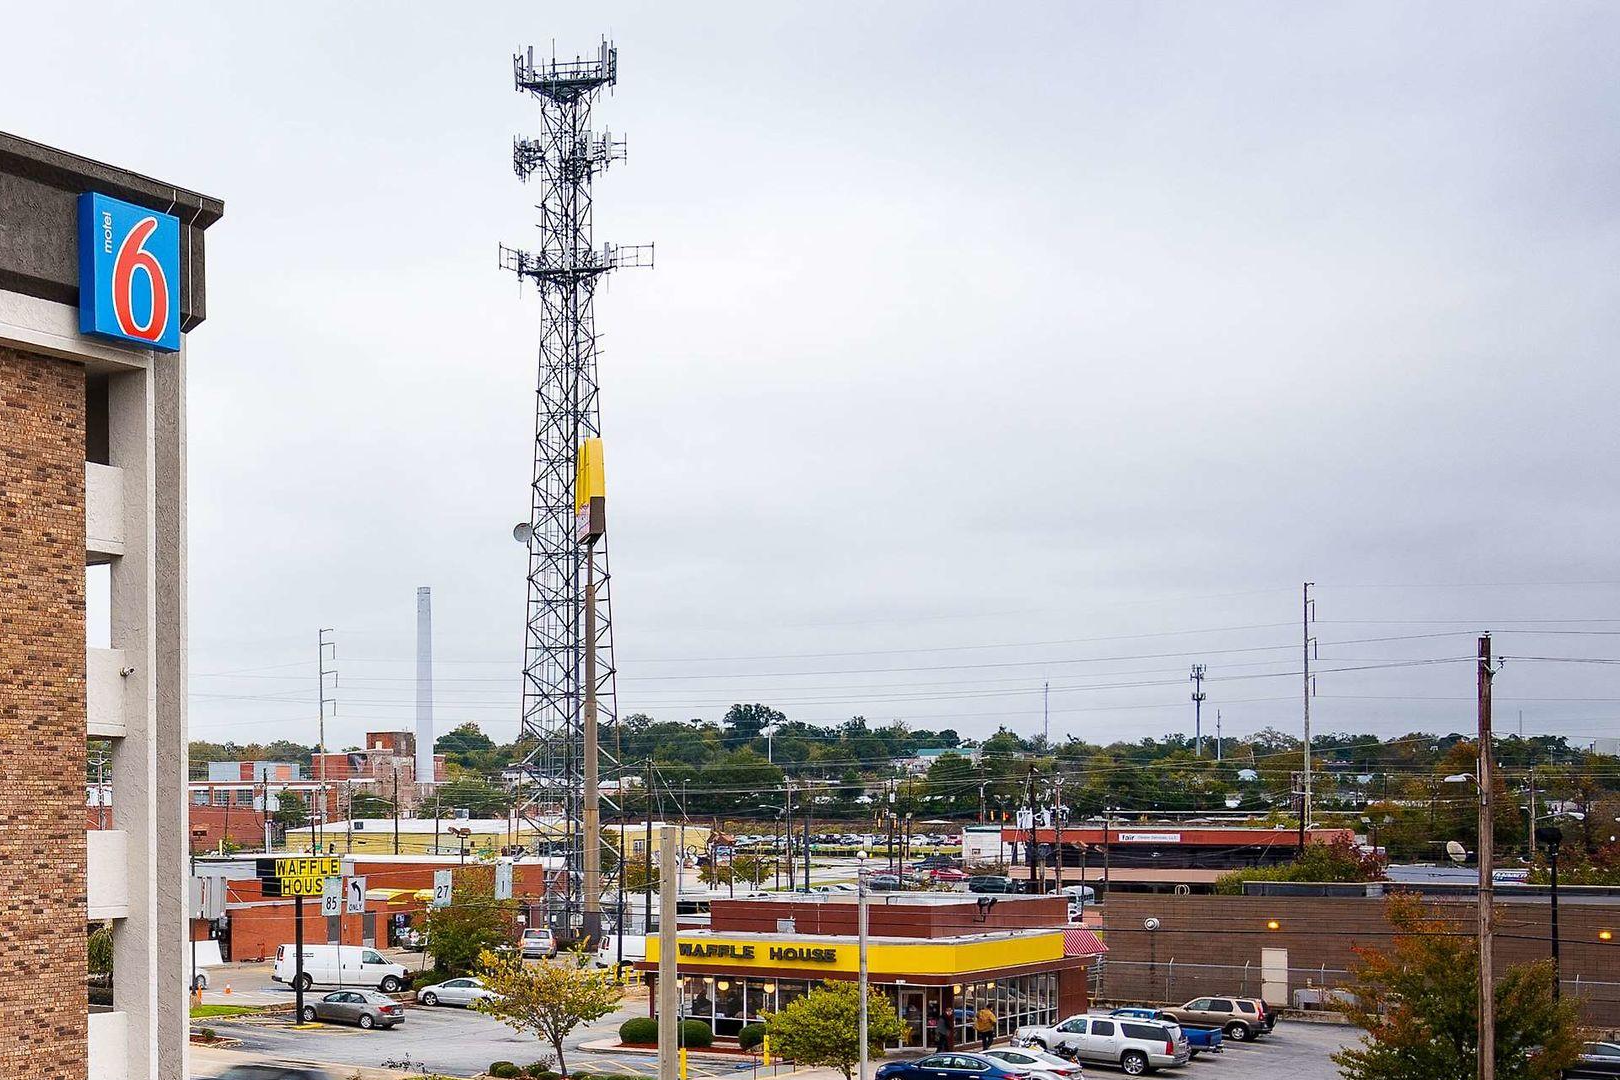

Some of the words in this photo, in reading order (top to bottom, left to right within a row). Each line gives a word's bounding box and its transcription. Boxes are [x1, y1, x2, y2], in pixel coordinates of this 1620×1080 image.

[102, 211, 112, 253] motel
[112, 216, 169, 342] 6
[276, 859, 339, 876] WAFFLE
[283, 878, 323, 895] HOUS
[437, 884, 449, 899] 27
[326, 896, 337, 910] 85
[348, 903, 362, 911] ONLY
[678, 943, 755, 960] WAFFLE
[769, 947, 837, 963] HOUSE
